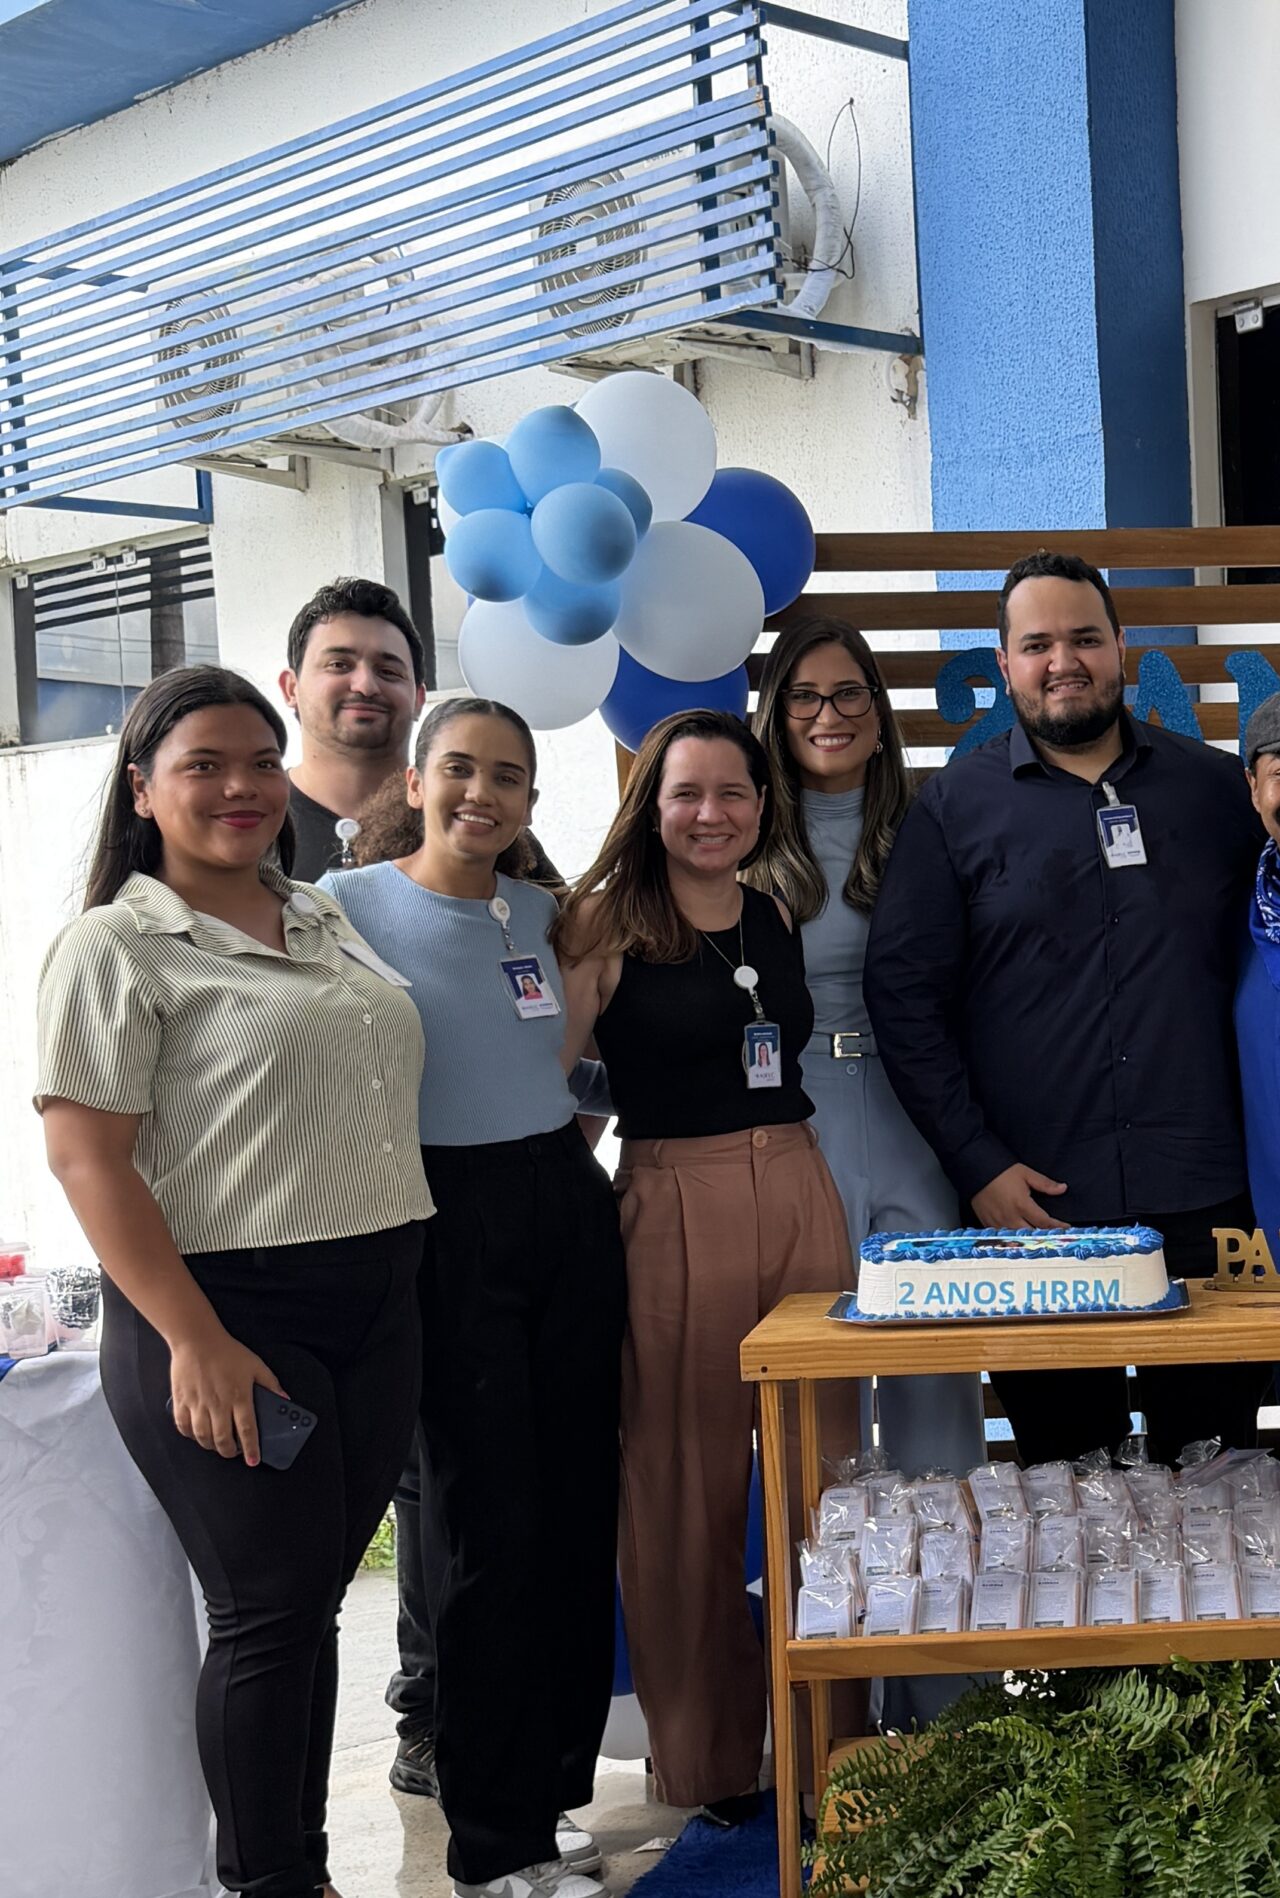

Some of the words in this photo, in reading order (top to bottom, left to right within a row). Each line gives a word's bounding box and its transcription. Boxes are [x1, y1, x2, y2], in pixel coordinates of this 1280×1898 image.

[898, 1281, 915, 1306] 2
[924, 1280, 1015, 1306] ANOS
[1026, 1278, 1120, 1306] HRRM
